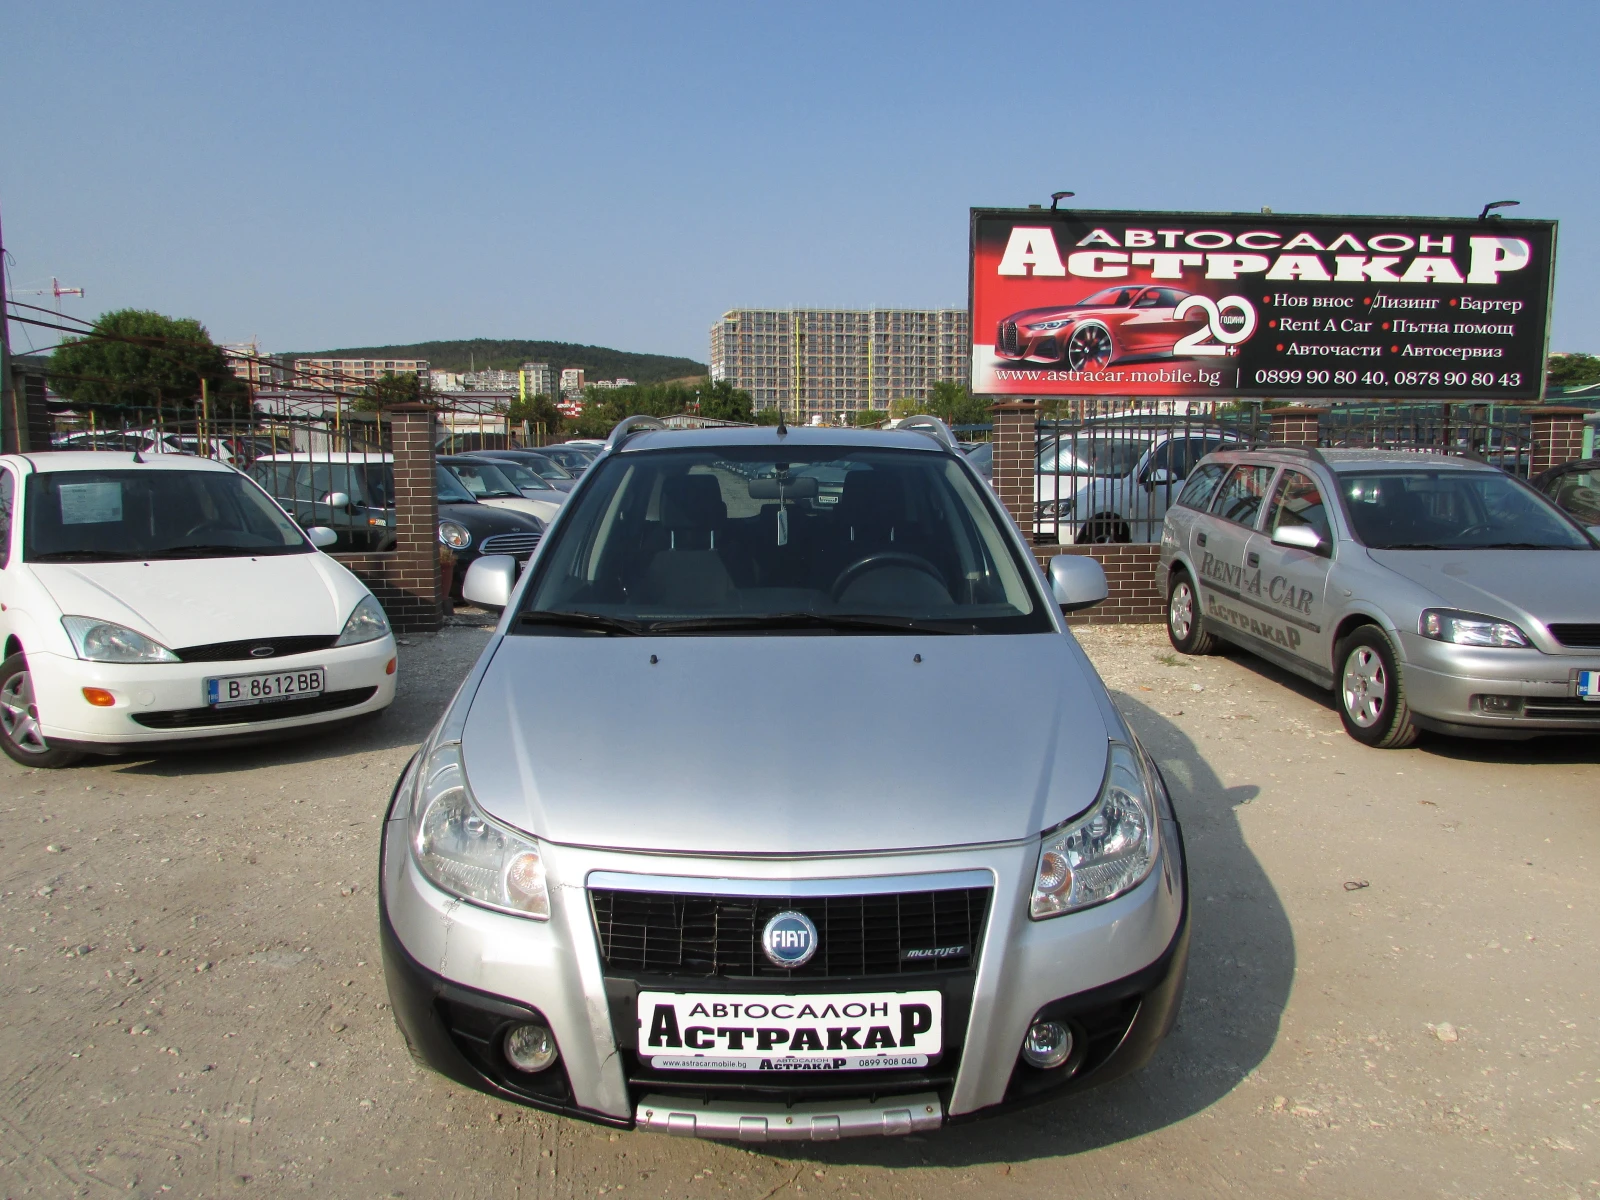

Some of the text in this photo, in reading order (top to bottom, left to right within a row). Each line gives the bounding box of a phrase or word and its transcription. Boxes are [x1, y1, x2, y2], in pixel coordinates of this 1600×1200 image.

[1076, 229, 1453, 253] АВТОСАЛОН
[1273, 293, 1354, 308] Нов внос
[1373, 295, 1440, 309] Лизинг
[1459, 296, 1523, 314] Бартер
[1279, 317, 1373, 333] Rent A Car
[1392, 319, 1514, 337] Пътна помощ
[1286, 342, 1383, 357] Авточасти
[1401, 343, 1503, 361] Автосервиз
[995, 367, 1221, 387] www.astracar.mobile.bg
[1255, 369, 1303, 384] 0899
[1306, 370, 1331, 385] 90
[1333, 371, 1358, 385] 80
[1394, 371, 1441, 386] 0878
[1444, 372, 1468, 386] 90
[1471, 373, 1494, 387] 80
[1498, 373, 1521, 387] 43
[772, 930, 808, 948] FIAT
[906, 945, 965, 958] MULTIJET
[688, 1002, 889, 1019] АВТОСАЛОН
[859, 1057, 918, 1067] 0899 908 040
